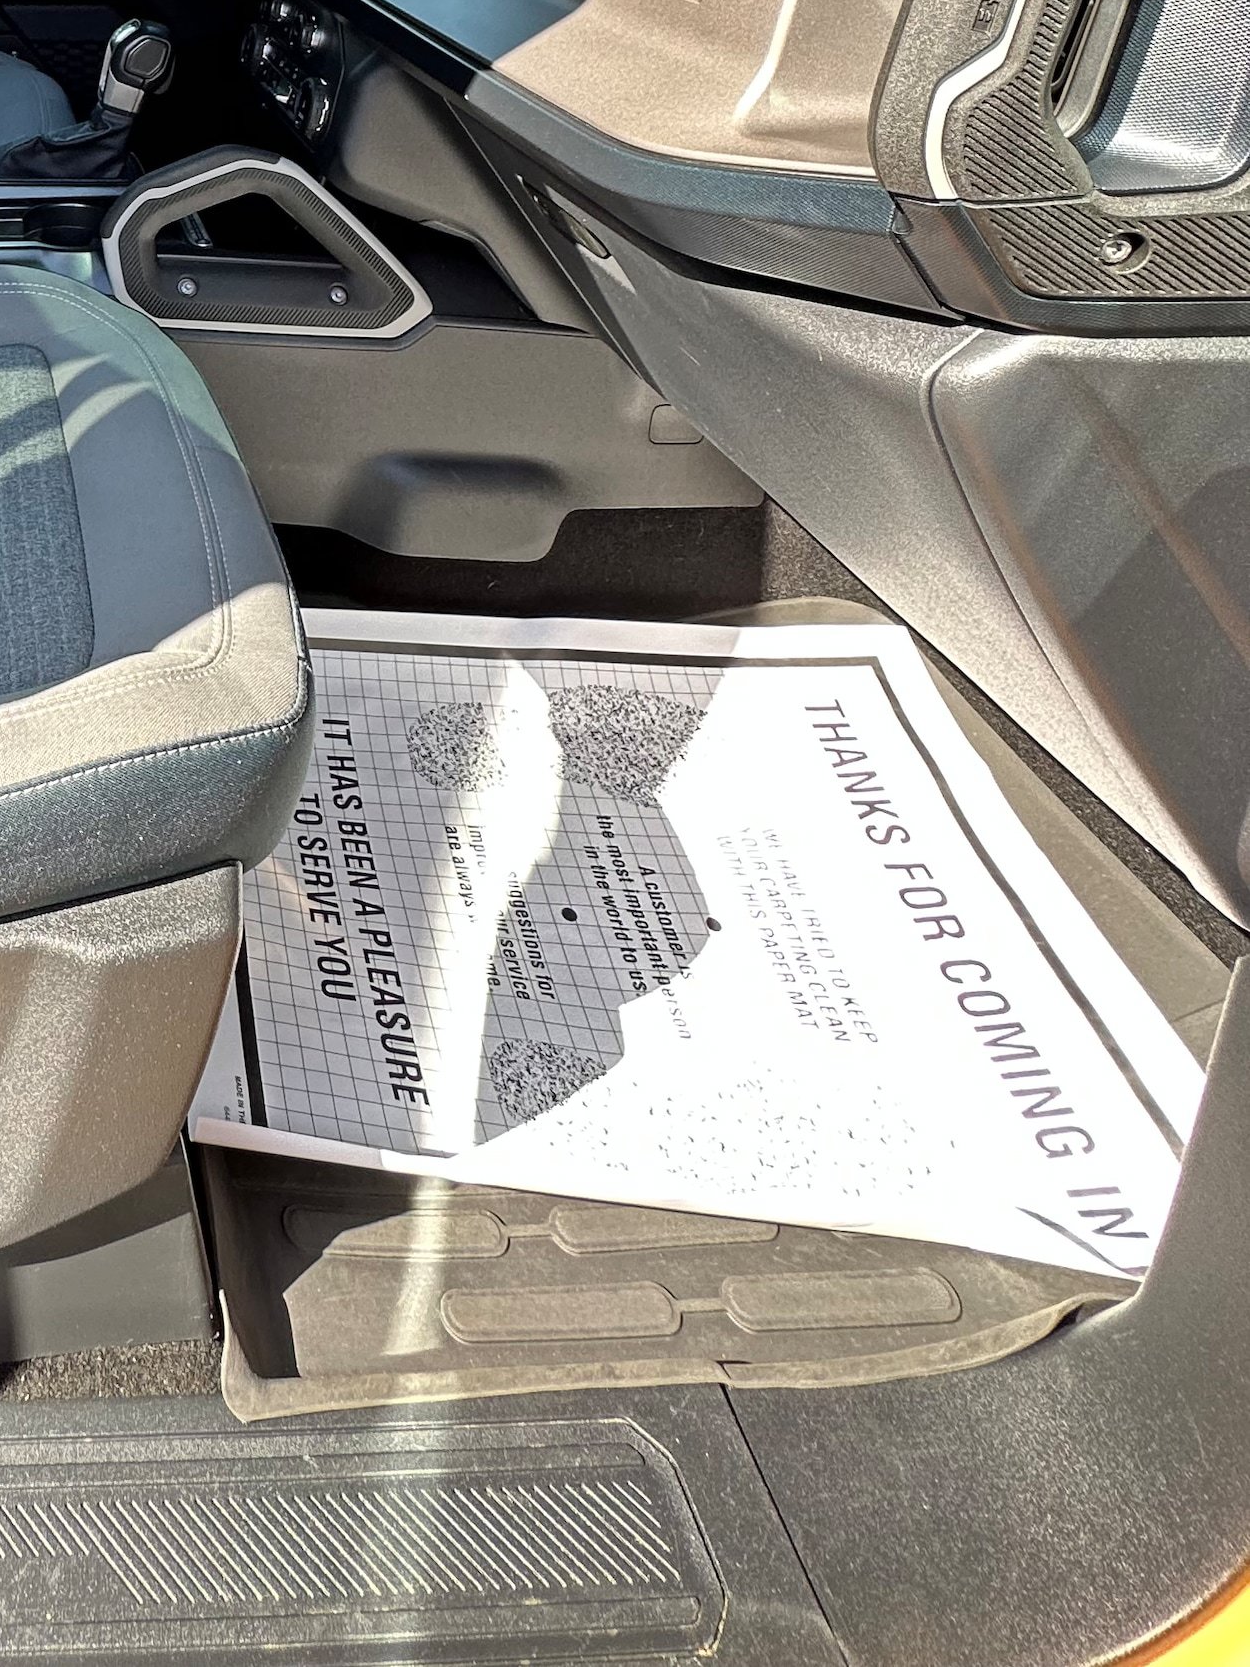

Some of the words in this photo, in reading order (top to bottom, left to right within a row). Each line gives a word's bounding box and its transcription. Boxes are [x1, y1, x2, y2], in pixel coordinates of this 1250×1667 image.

[322, 718, 352, 745] IT
[293, 793, 323, 826] TO
[327, 755, 363, 810] HAS
[337, 820, 380, 890] BEEN
[445, 825, 462, 851] are
[583, 845, 600, 860] in
[297, 835, 342, 926] SERVE
[452, 855, 477, 908] always
[591, 864, 610, 890] the
[638, 864, 656, 877] A
[352, 897, 385, 916] A
[597, 814, 614, 839] the
[607, 845, 634, 884] most
[623, 889, 669, 971] important
[652, 974, 692, 1040] person
[601, 894, 633, 943] world
[645, 882, 687, 961] customer
[717, 836, 747, 876] WITH
[740, 884, 766, 919] THIS
[759, 927, 796, 983] PAPER
[787, 991, 819, 1029] MAT
[313, 936, 357, 1002] YOU
[501, 938, 531, 1001] service
[620, 947, 637, 964] to
[760, 877, 817, 975] CARPETING
[809, 982, 851, 1041] CLEAN
[776, 859, 806, 896] HAVE
[801, 909, 835, 958] TRIED
[828, 968, 850, 988] TO
[841, 996, 878, 1043] KEEP
[805, 699, 910, 844] THANKS
[884, 863, 965, 941] FOR
[940, 959, 1095, 1158] COMING
[1066, 1186, 1149, 1238] IN
[536, 974, 555, 1001] for
[358, 927, 431, 1106] PLEASURE
